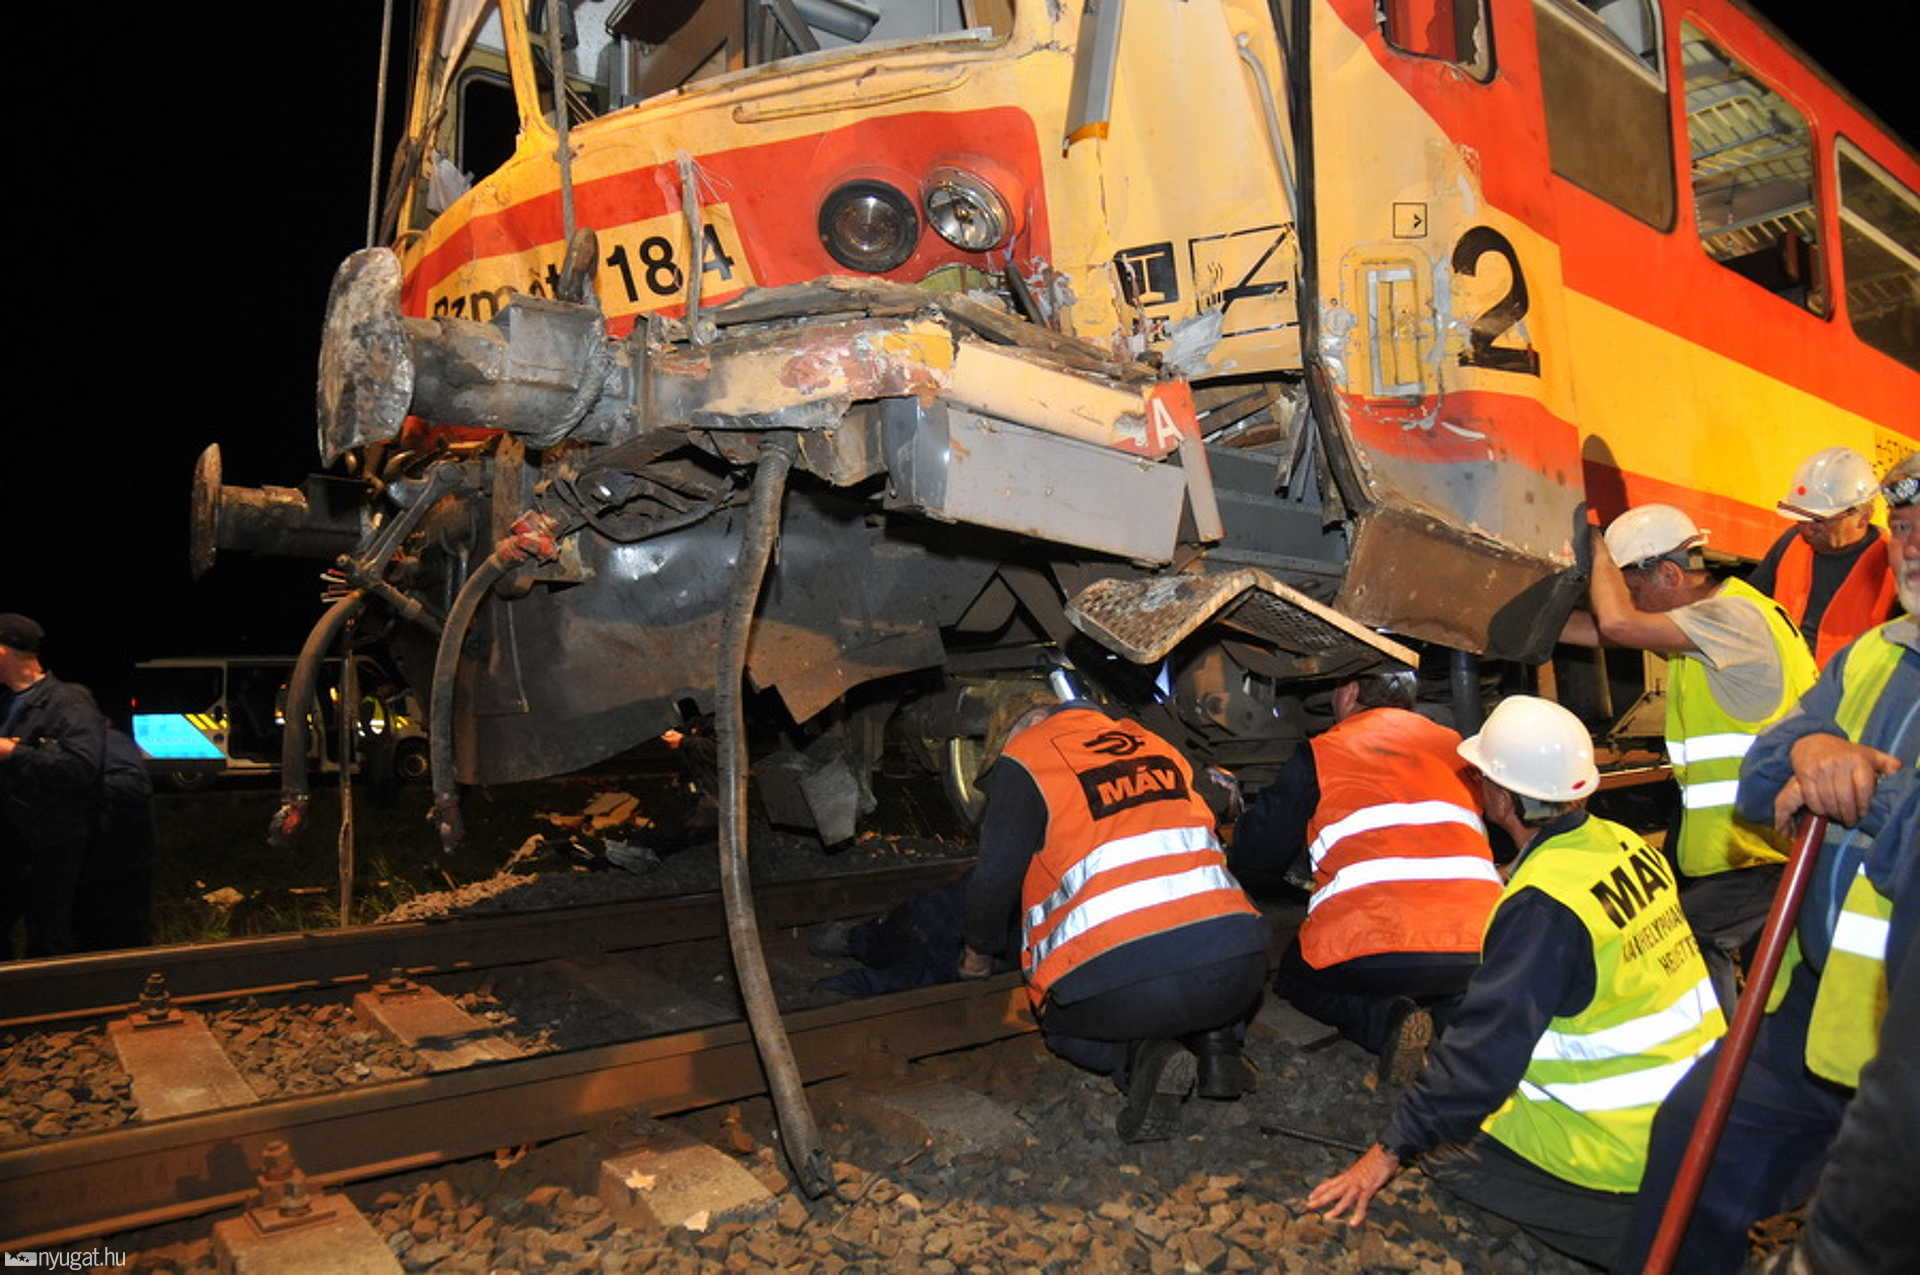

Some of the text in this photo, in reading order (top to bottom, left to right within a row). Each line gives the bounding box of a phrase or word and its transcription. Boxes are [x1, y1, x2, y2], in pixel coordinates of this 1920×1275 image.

[1452, 225, 1540, 376] 2
[1152, 397, 1184, 449] A
[1096, 765, 1178, 806] MÁV
